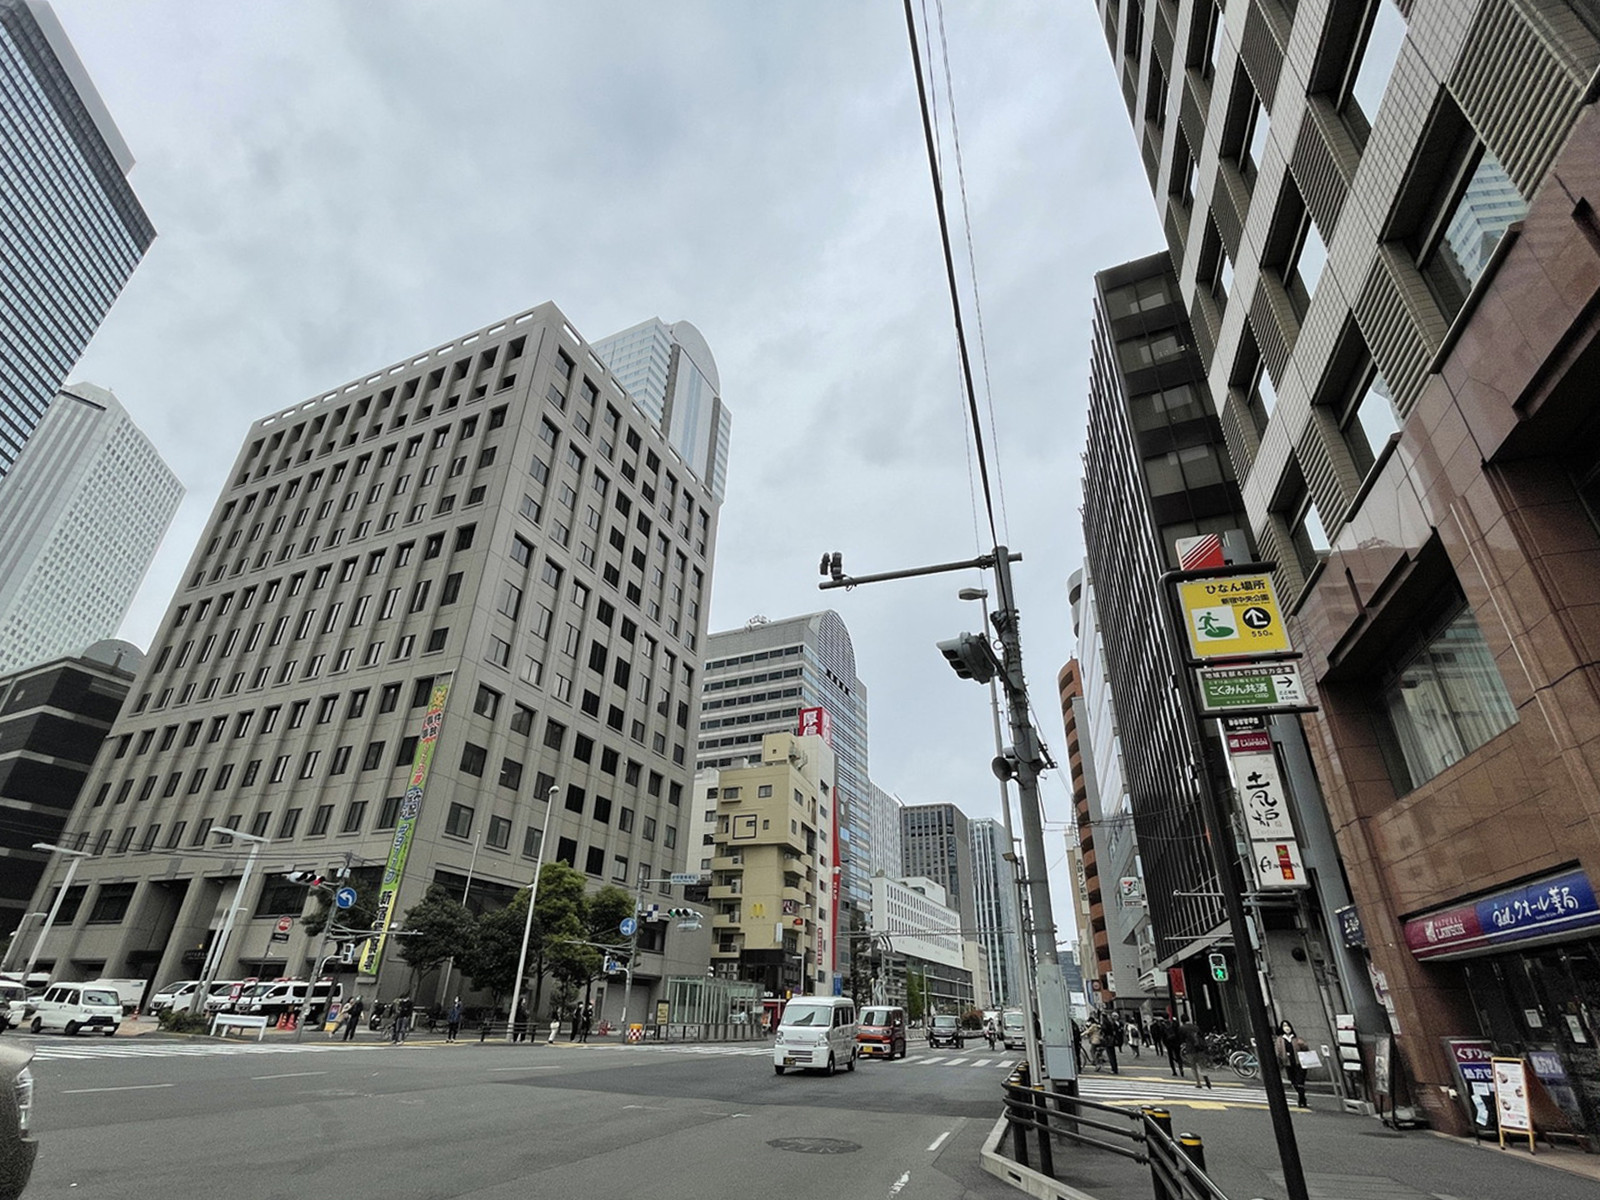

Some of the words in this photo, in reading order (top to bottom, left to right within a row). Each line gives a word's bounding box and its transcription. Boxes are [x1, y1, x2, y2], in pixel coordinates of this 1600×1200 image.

[1205, 580, 1265, 594] ひなん場所
[1209, 682, 1268, 696] こくみん共済
[1514, 886, 1579, 920] クオール薬局
[1436, 923, 1466, 939] LAWSON
[1457, 1048, 1483, 1060] くすり
